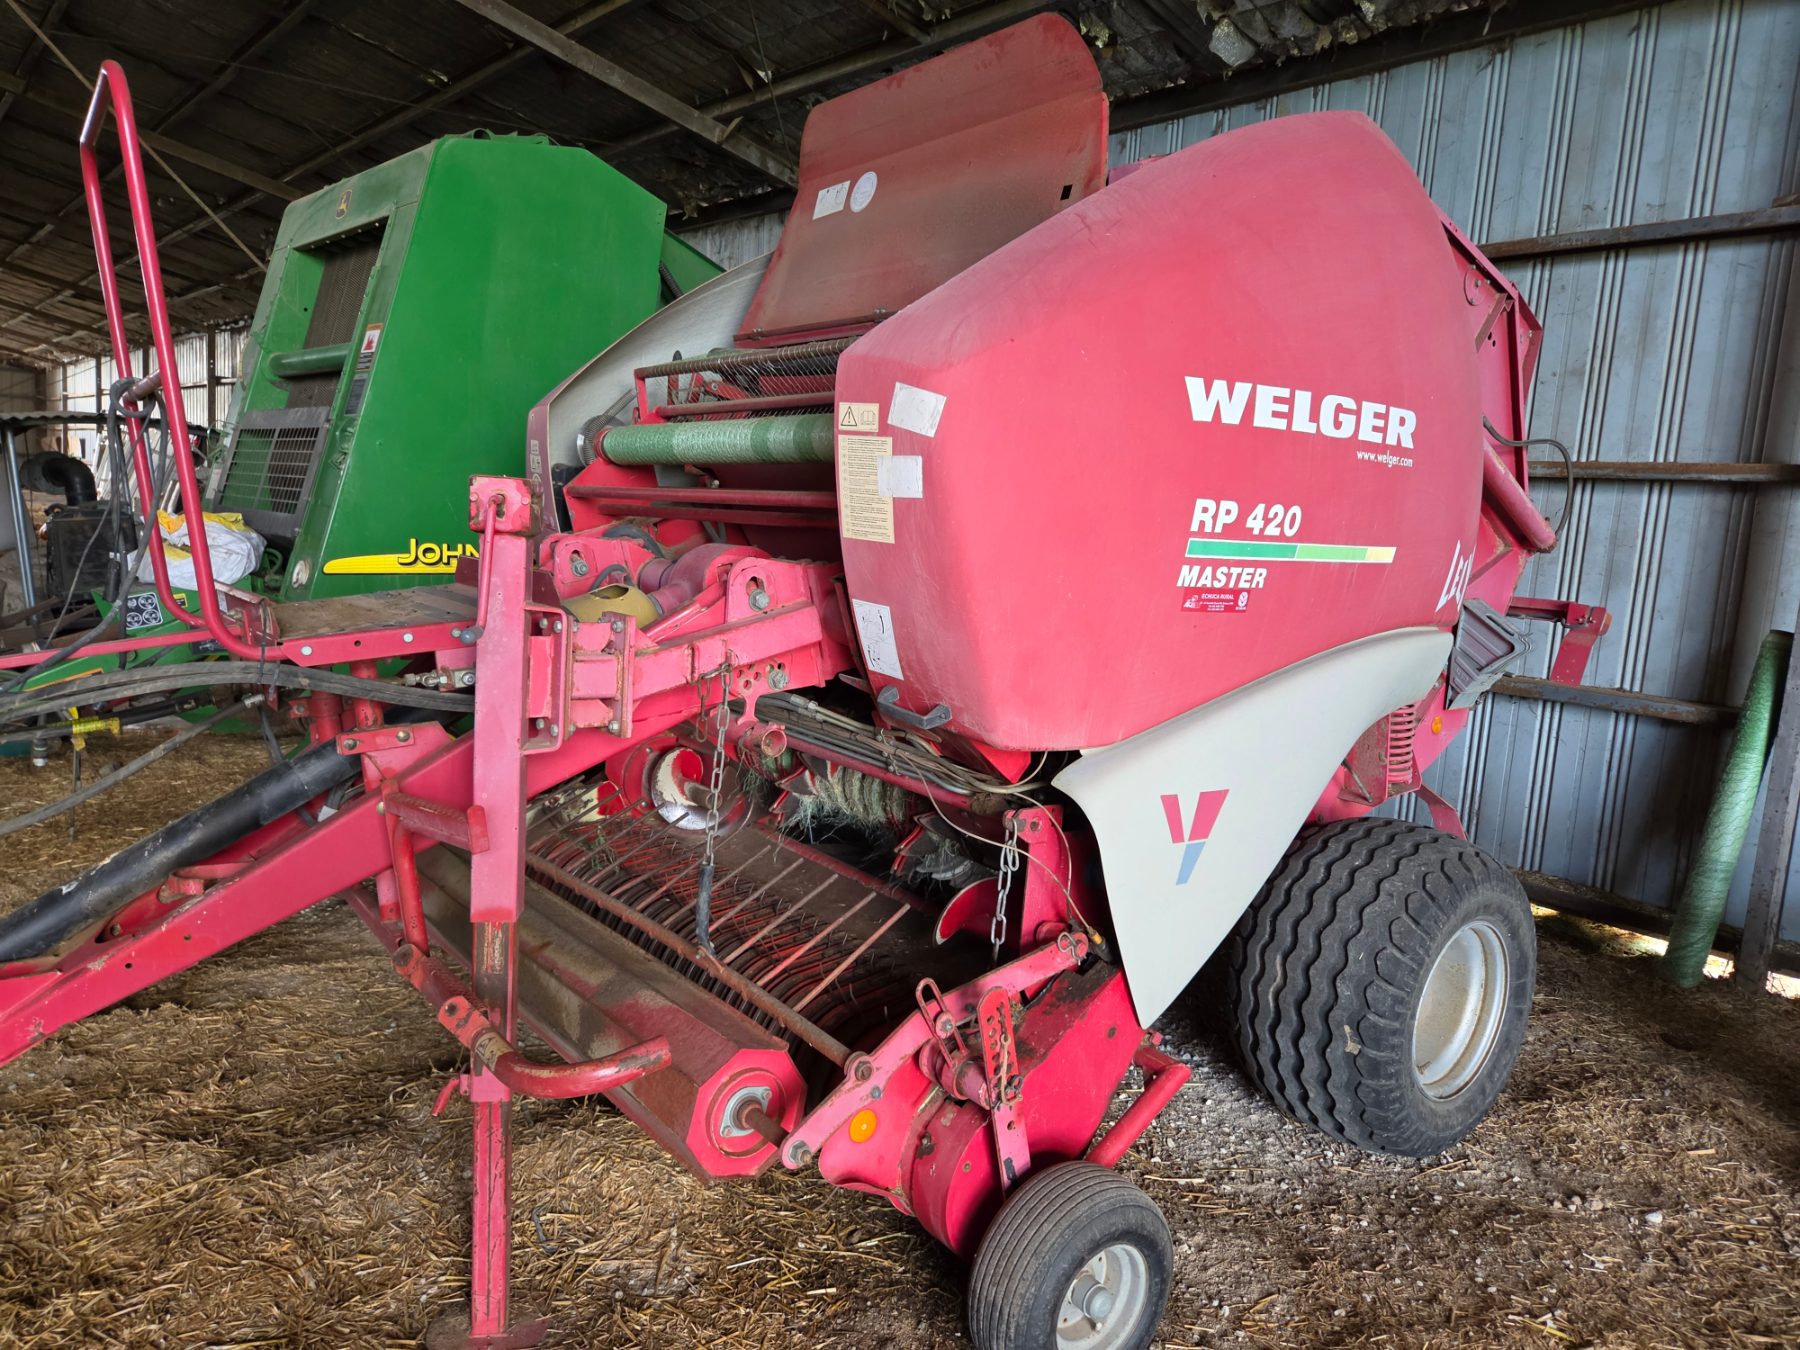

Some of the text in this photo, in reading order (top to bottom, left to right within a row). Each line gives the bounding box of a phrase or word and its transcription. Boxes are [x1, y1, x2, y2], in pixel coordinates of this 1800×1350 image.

[1184, 375, 1417, 449] WELGER
[1357, 450, 1413, 468] www.welger.com
[1190, 498, 1302, 537] RP 420
[1176, 565, 1268, 588] MASTER
